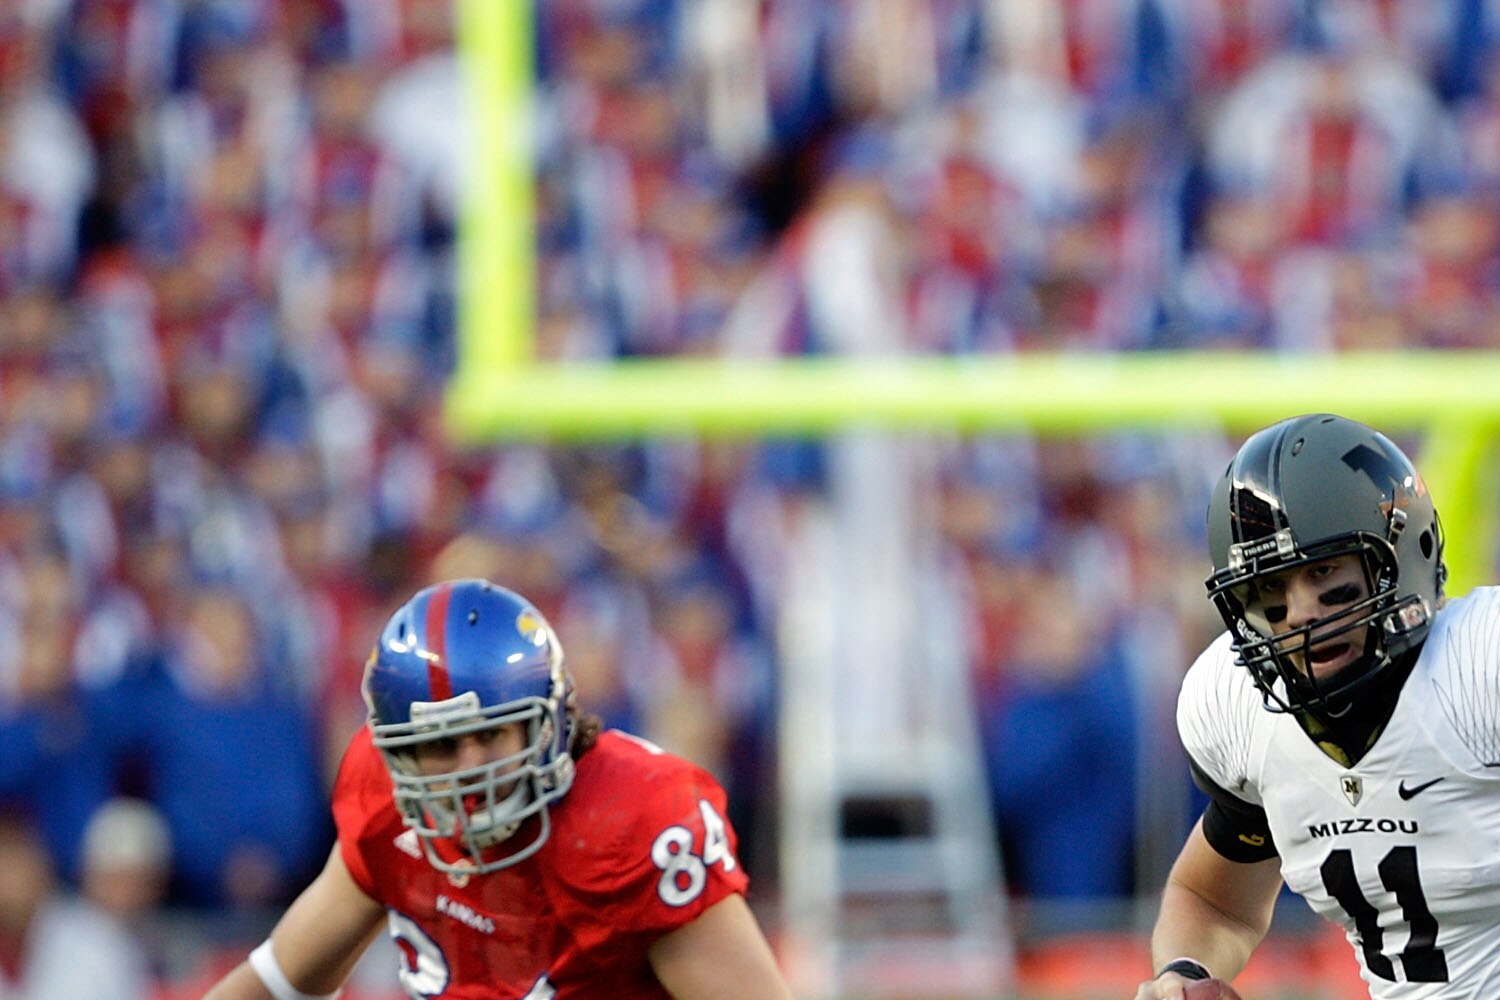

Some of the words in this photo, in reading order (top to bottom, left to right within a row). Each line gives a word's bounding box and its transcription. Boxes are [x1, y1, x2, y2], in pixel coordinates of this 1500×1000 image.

[650, 797, 738, 908] 84
[1308, 818, 1419, 839] MIZZOU
[1320, 845, 1450, 984] 11
